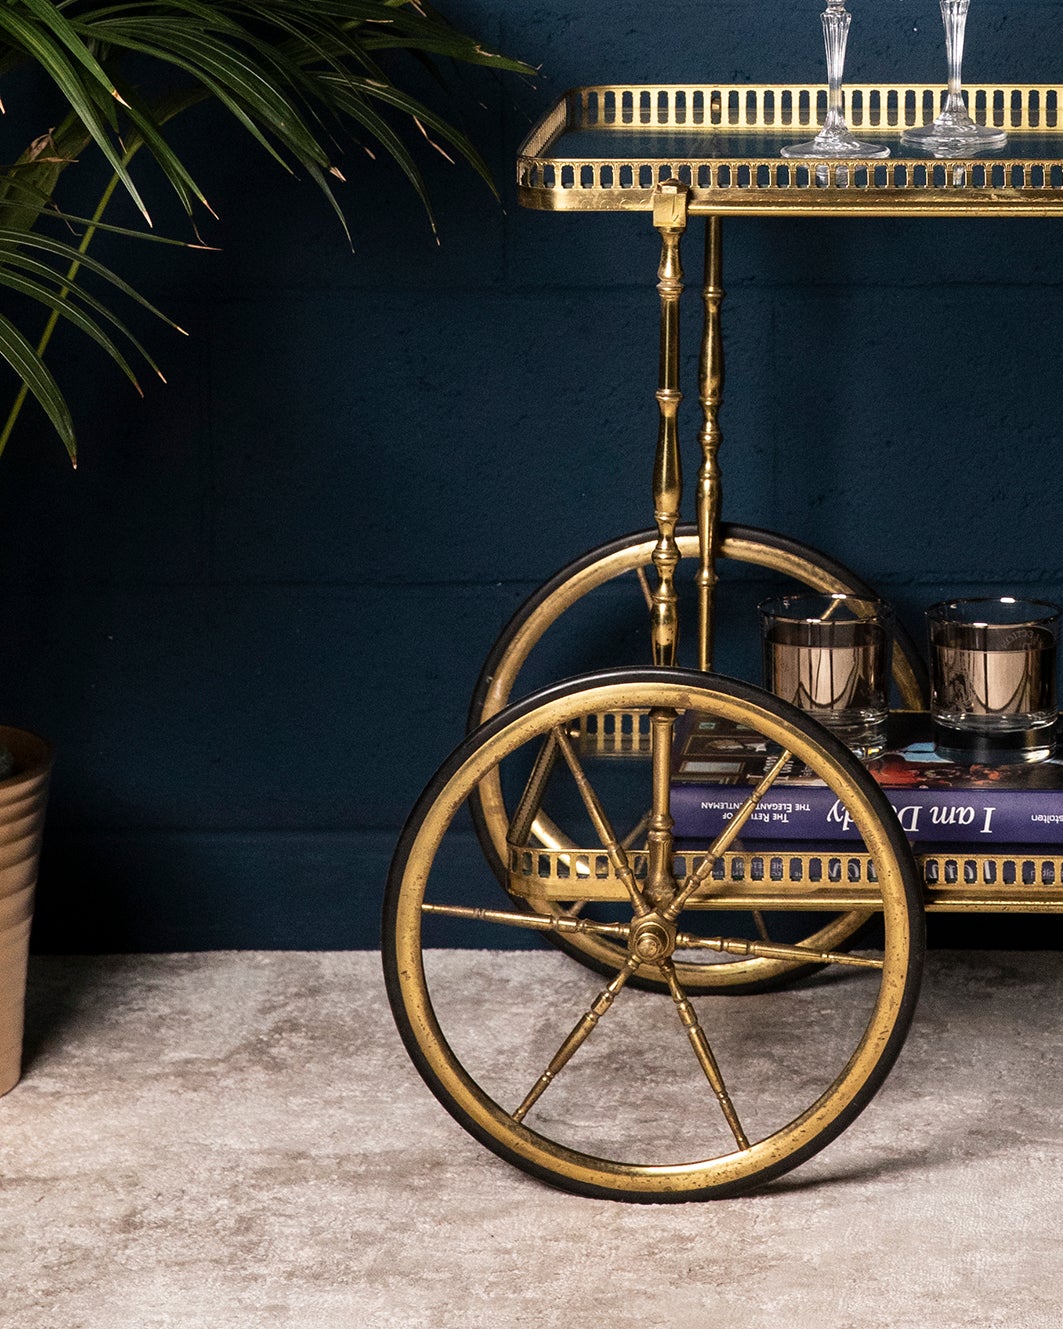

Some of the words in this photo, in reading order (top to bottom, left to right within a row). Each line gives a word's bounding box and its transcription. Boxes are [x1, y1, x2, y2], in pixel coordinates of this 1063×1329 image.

[701, 801, 743, 809] NTLEMAN
[929, 805, 975, 825] am
[980, 807, 996, 833] I
